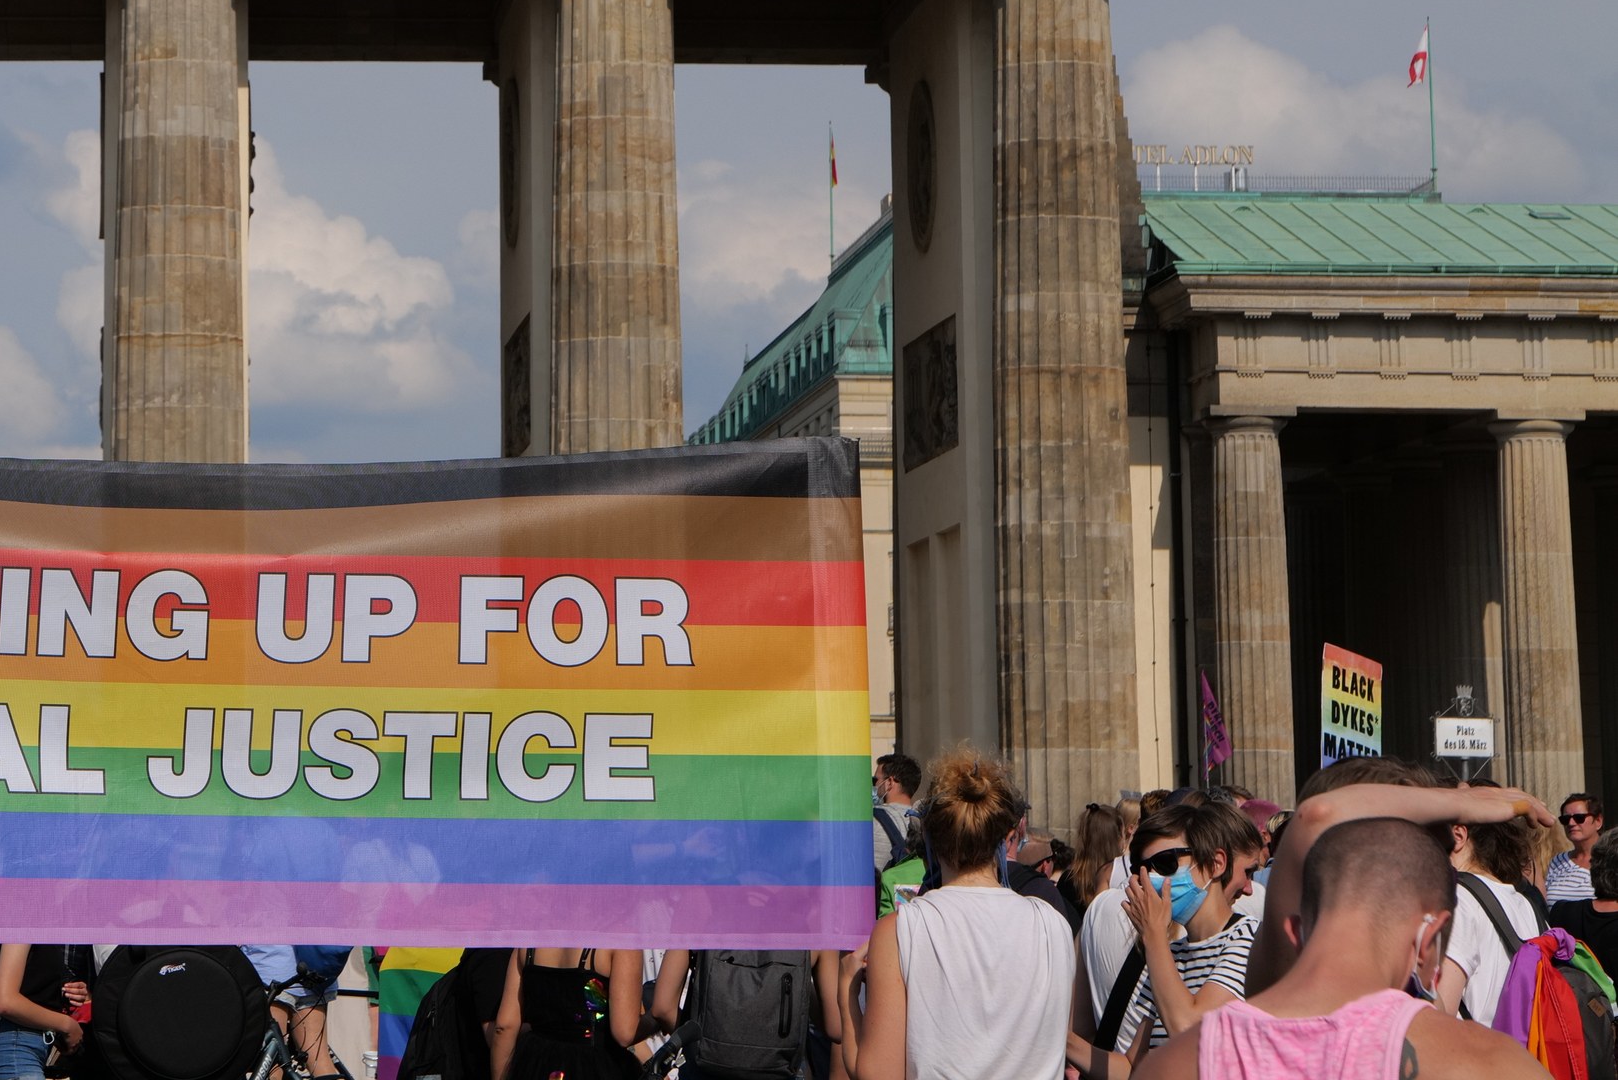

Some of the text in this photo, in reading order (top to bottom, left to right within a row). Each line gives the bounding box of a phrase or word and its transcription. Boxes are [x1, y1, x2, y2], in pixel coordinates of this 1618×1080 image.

[1132, 144, 1254, 165] TEL ADLON
[256, 572, 418, 664] UP
[458, 575, 694, 667] FOR
[1332, 665, 1374, 703] BLACK
[1444, 739, 1487, 750] des 18. März
[1456, 726, 1475, 736] Platz
[147, 708, 657, 803] JUSTICE
